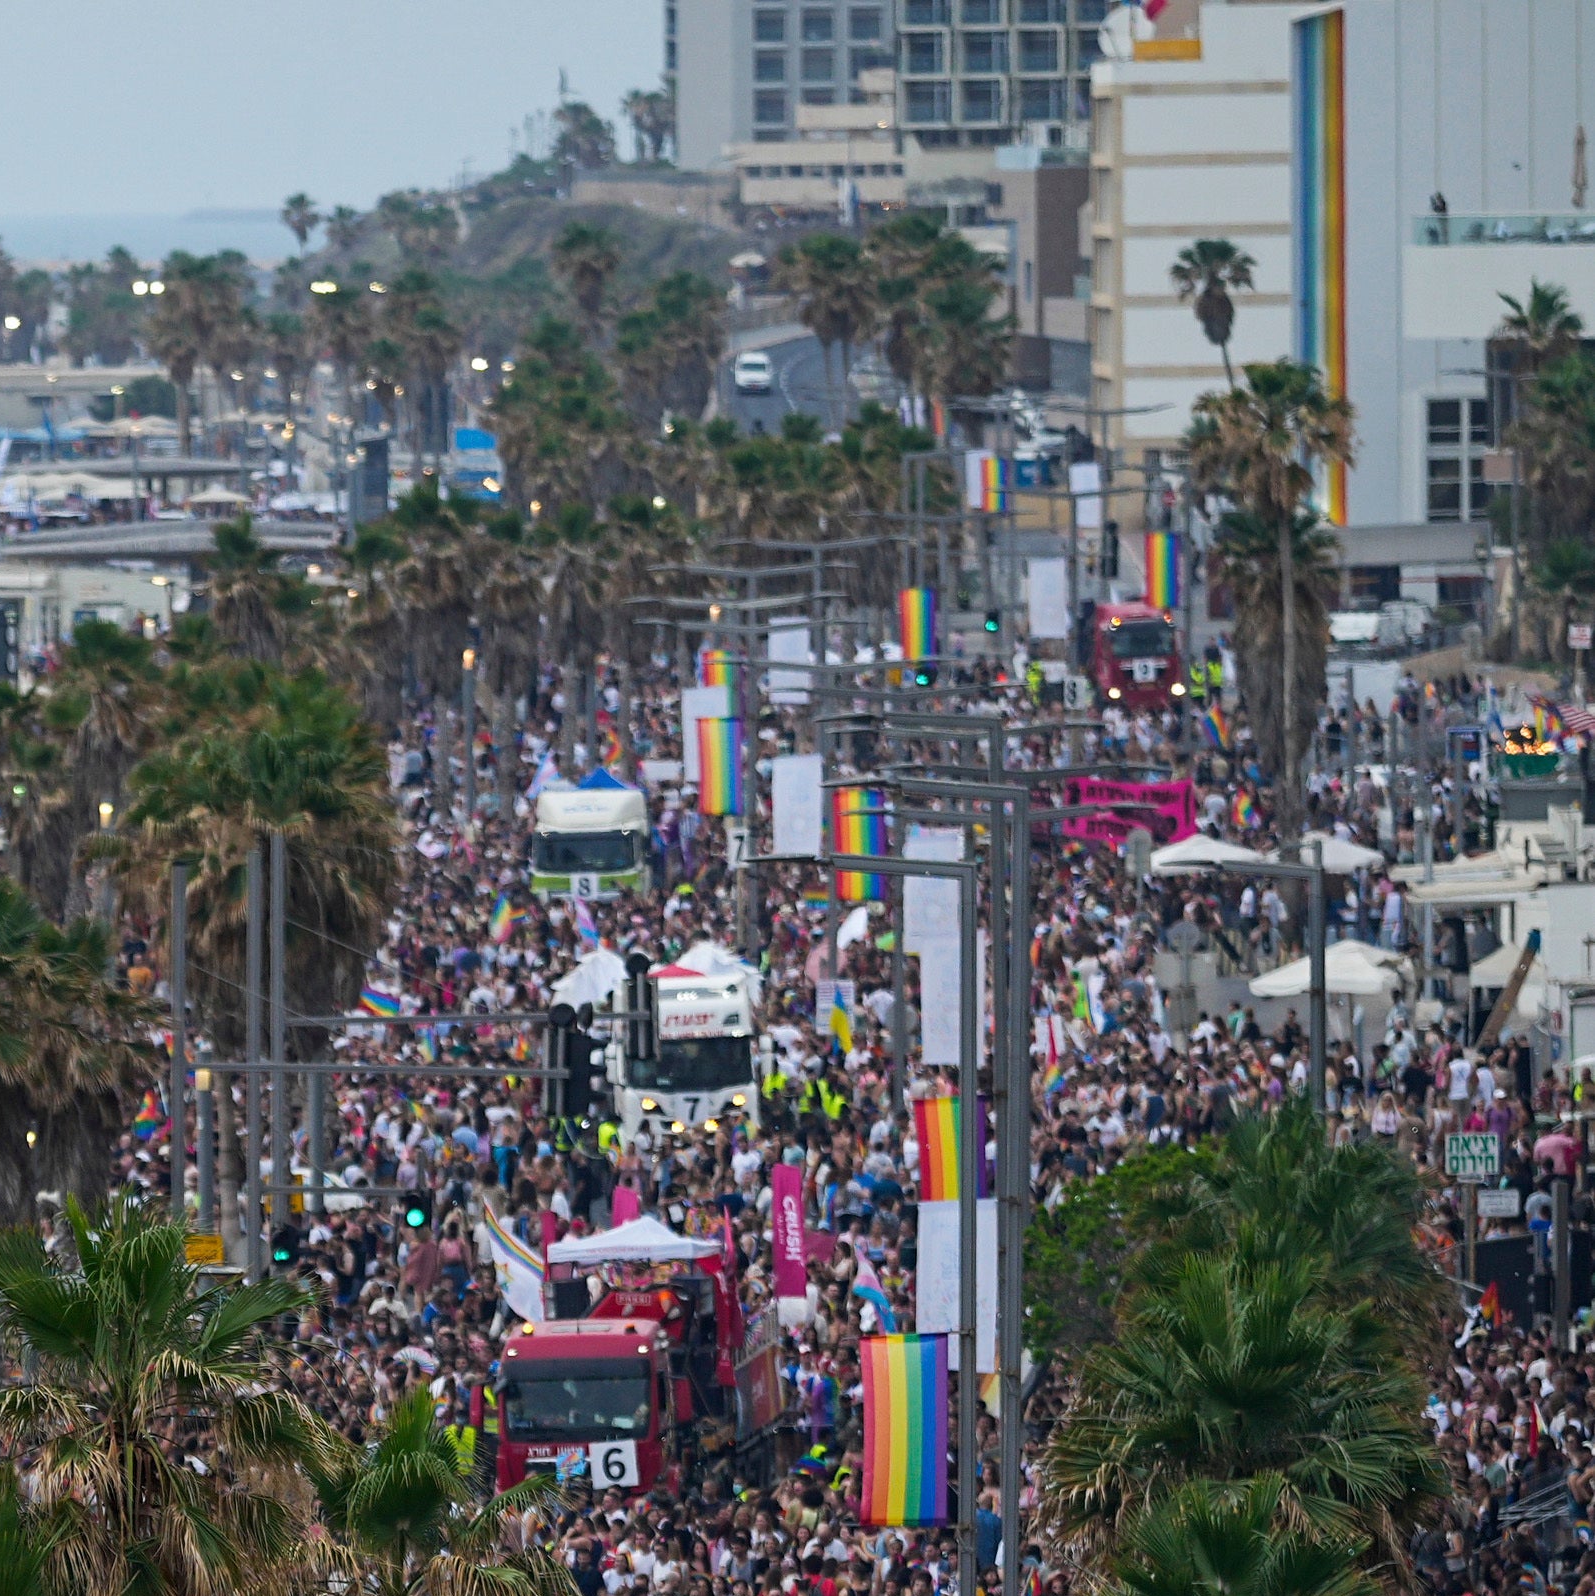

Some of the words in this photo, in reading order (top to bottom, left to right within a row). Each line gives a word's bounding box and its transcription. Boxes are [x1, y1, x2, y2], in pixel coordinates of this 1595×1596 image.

[733, 834, 745, 861] 7
[578, 877, 590, 897] 8
[683, 1096, 699, 1121] 7
[1448, 1136, 1497, 1154] יציאת
[1448, 1154, 1497, 1173] חירום
[783, 1195, 802, 1260] CRUSH
[602, 1448, 626, 1482] 6
